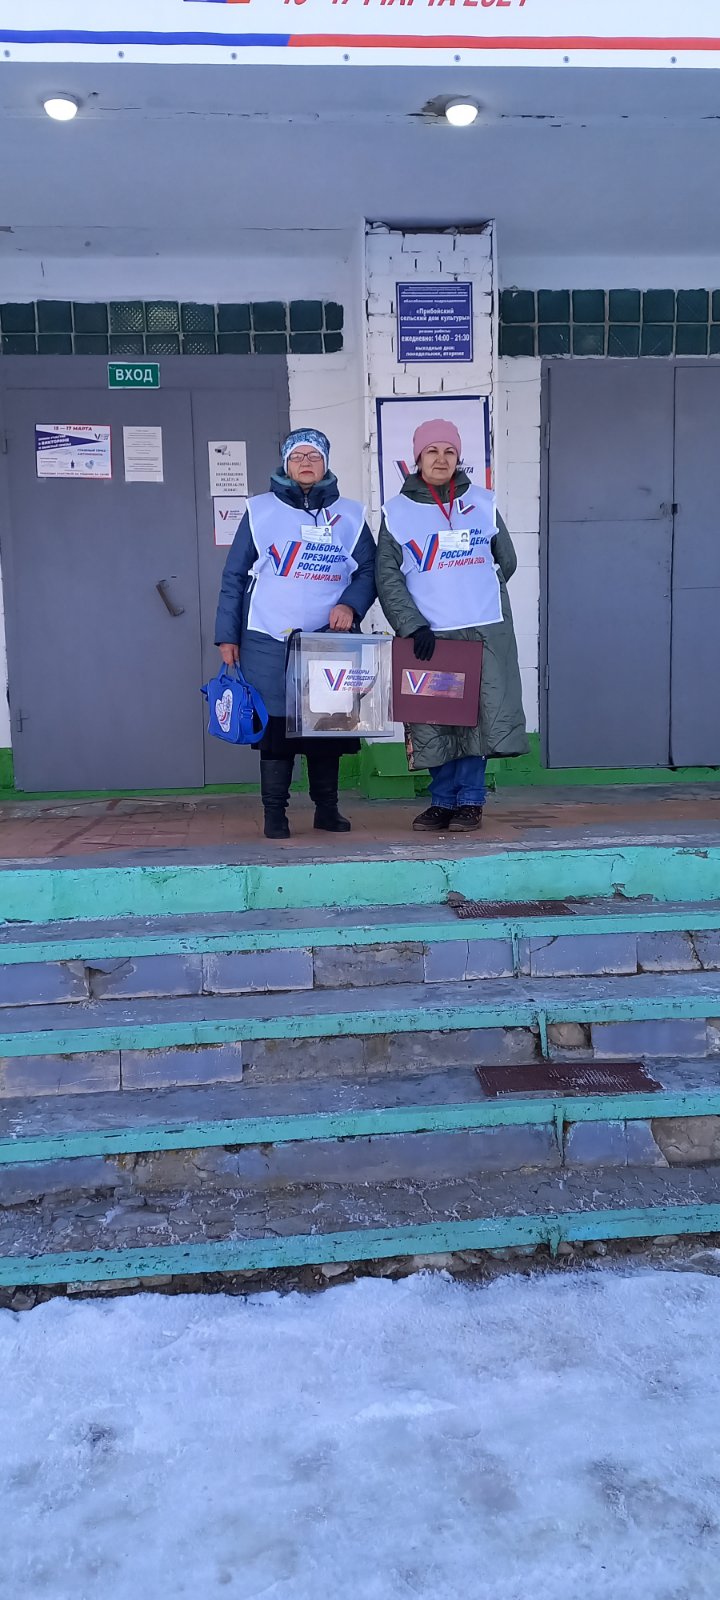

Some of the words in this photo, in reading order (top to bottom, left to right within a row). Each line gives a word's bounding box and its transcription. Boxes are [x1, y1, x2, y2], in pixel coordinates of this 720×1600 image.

[116, 369, 152, 383] ВХОД
[306, 543, 343, 553] ВЫБОРЫ
[440, 548, 473, 560] РОССИИ
[454, 557, 474, 566] МАРТА
[297, 562, 331, 572] РОССИИ
